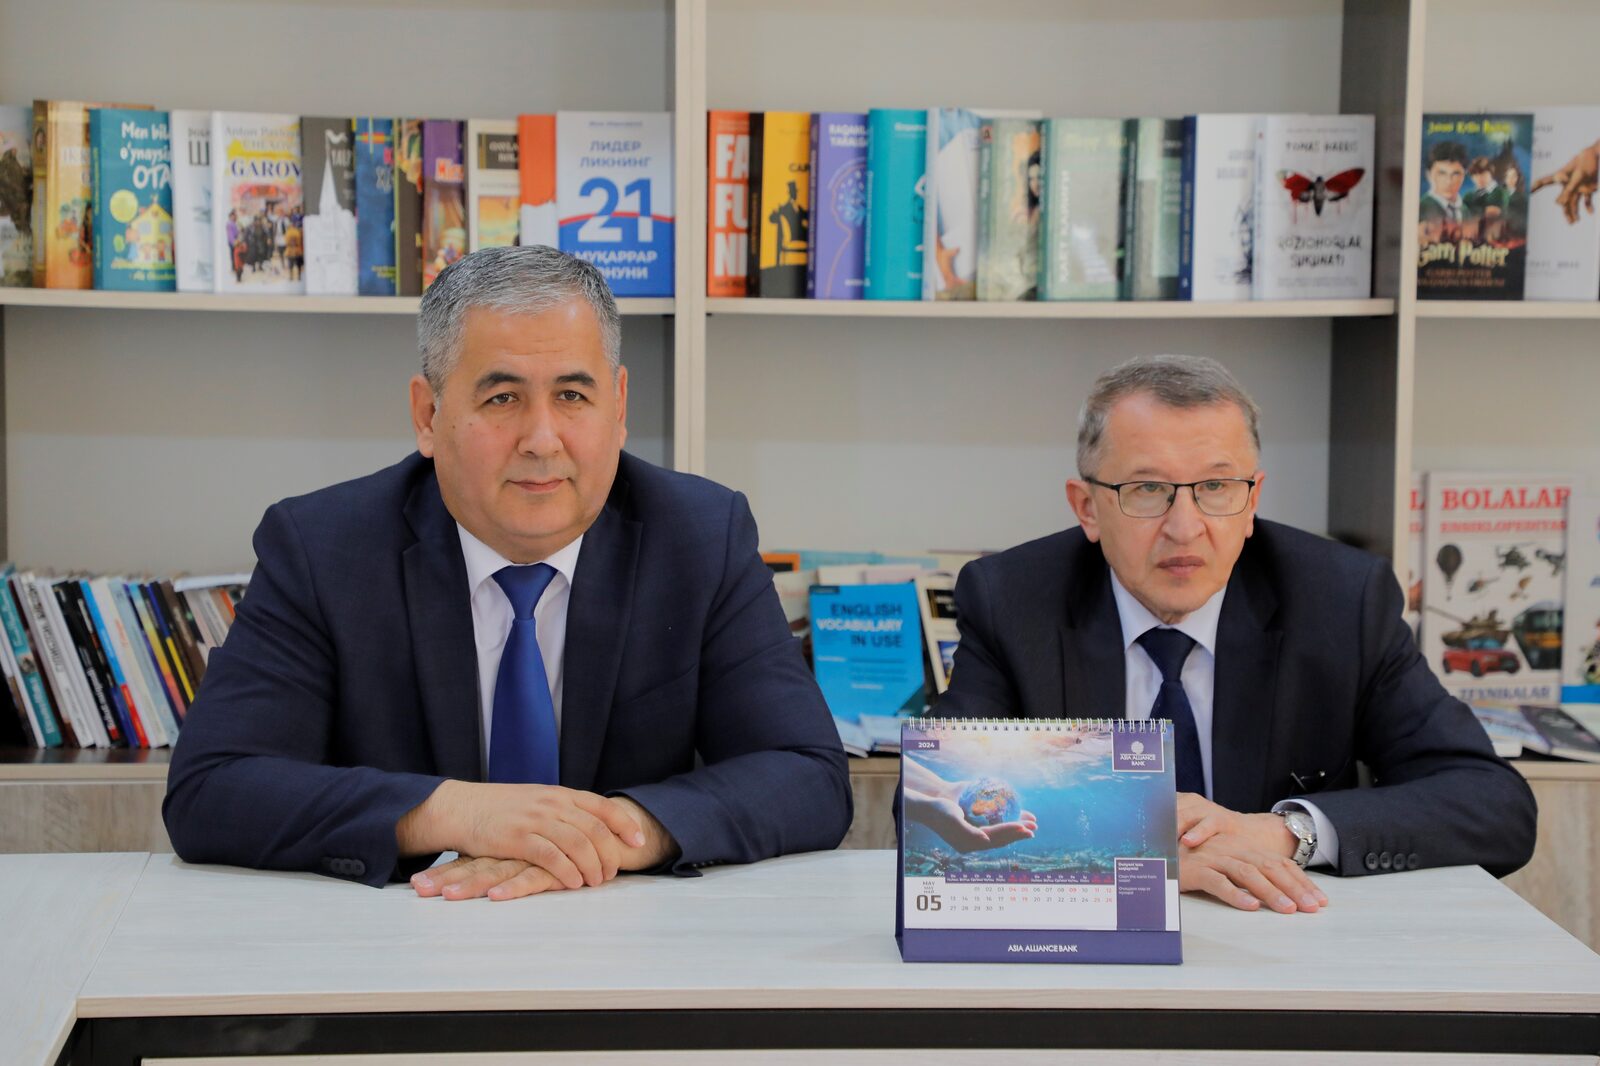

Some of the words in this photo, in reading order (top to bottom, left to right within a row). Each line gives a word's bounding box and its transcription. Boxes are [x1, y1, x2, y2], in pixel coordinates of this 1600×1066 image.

[122, 121, 148, 139] Men
[590, 140, 642, 152] ЛИДЕР
[580, 156, 652, 168] ЛИКНИНГ
[578, 176, 654, 242] 21
[1458, 240, 1509, 268] Potter
[1442, 486, 1572, 510] BOLALAR
[830, 603, 902, 617] ENGLISH
[816, 618, 904, 632] VOCABULARY
[850, 634, 866, 648] IN
[870, 634, 902, 648] USE
[916, 895, 942, 911] 05
[1008, 944, 1024, 952] ASIA
[1025, 944, 1058, 952] ALLIANCE
[1059, 944, 1078, 952] BANK
